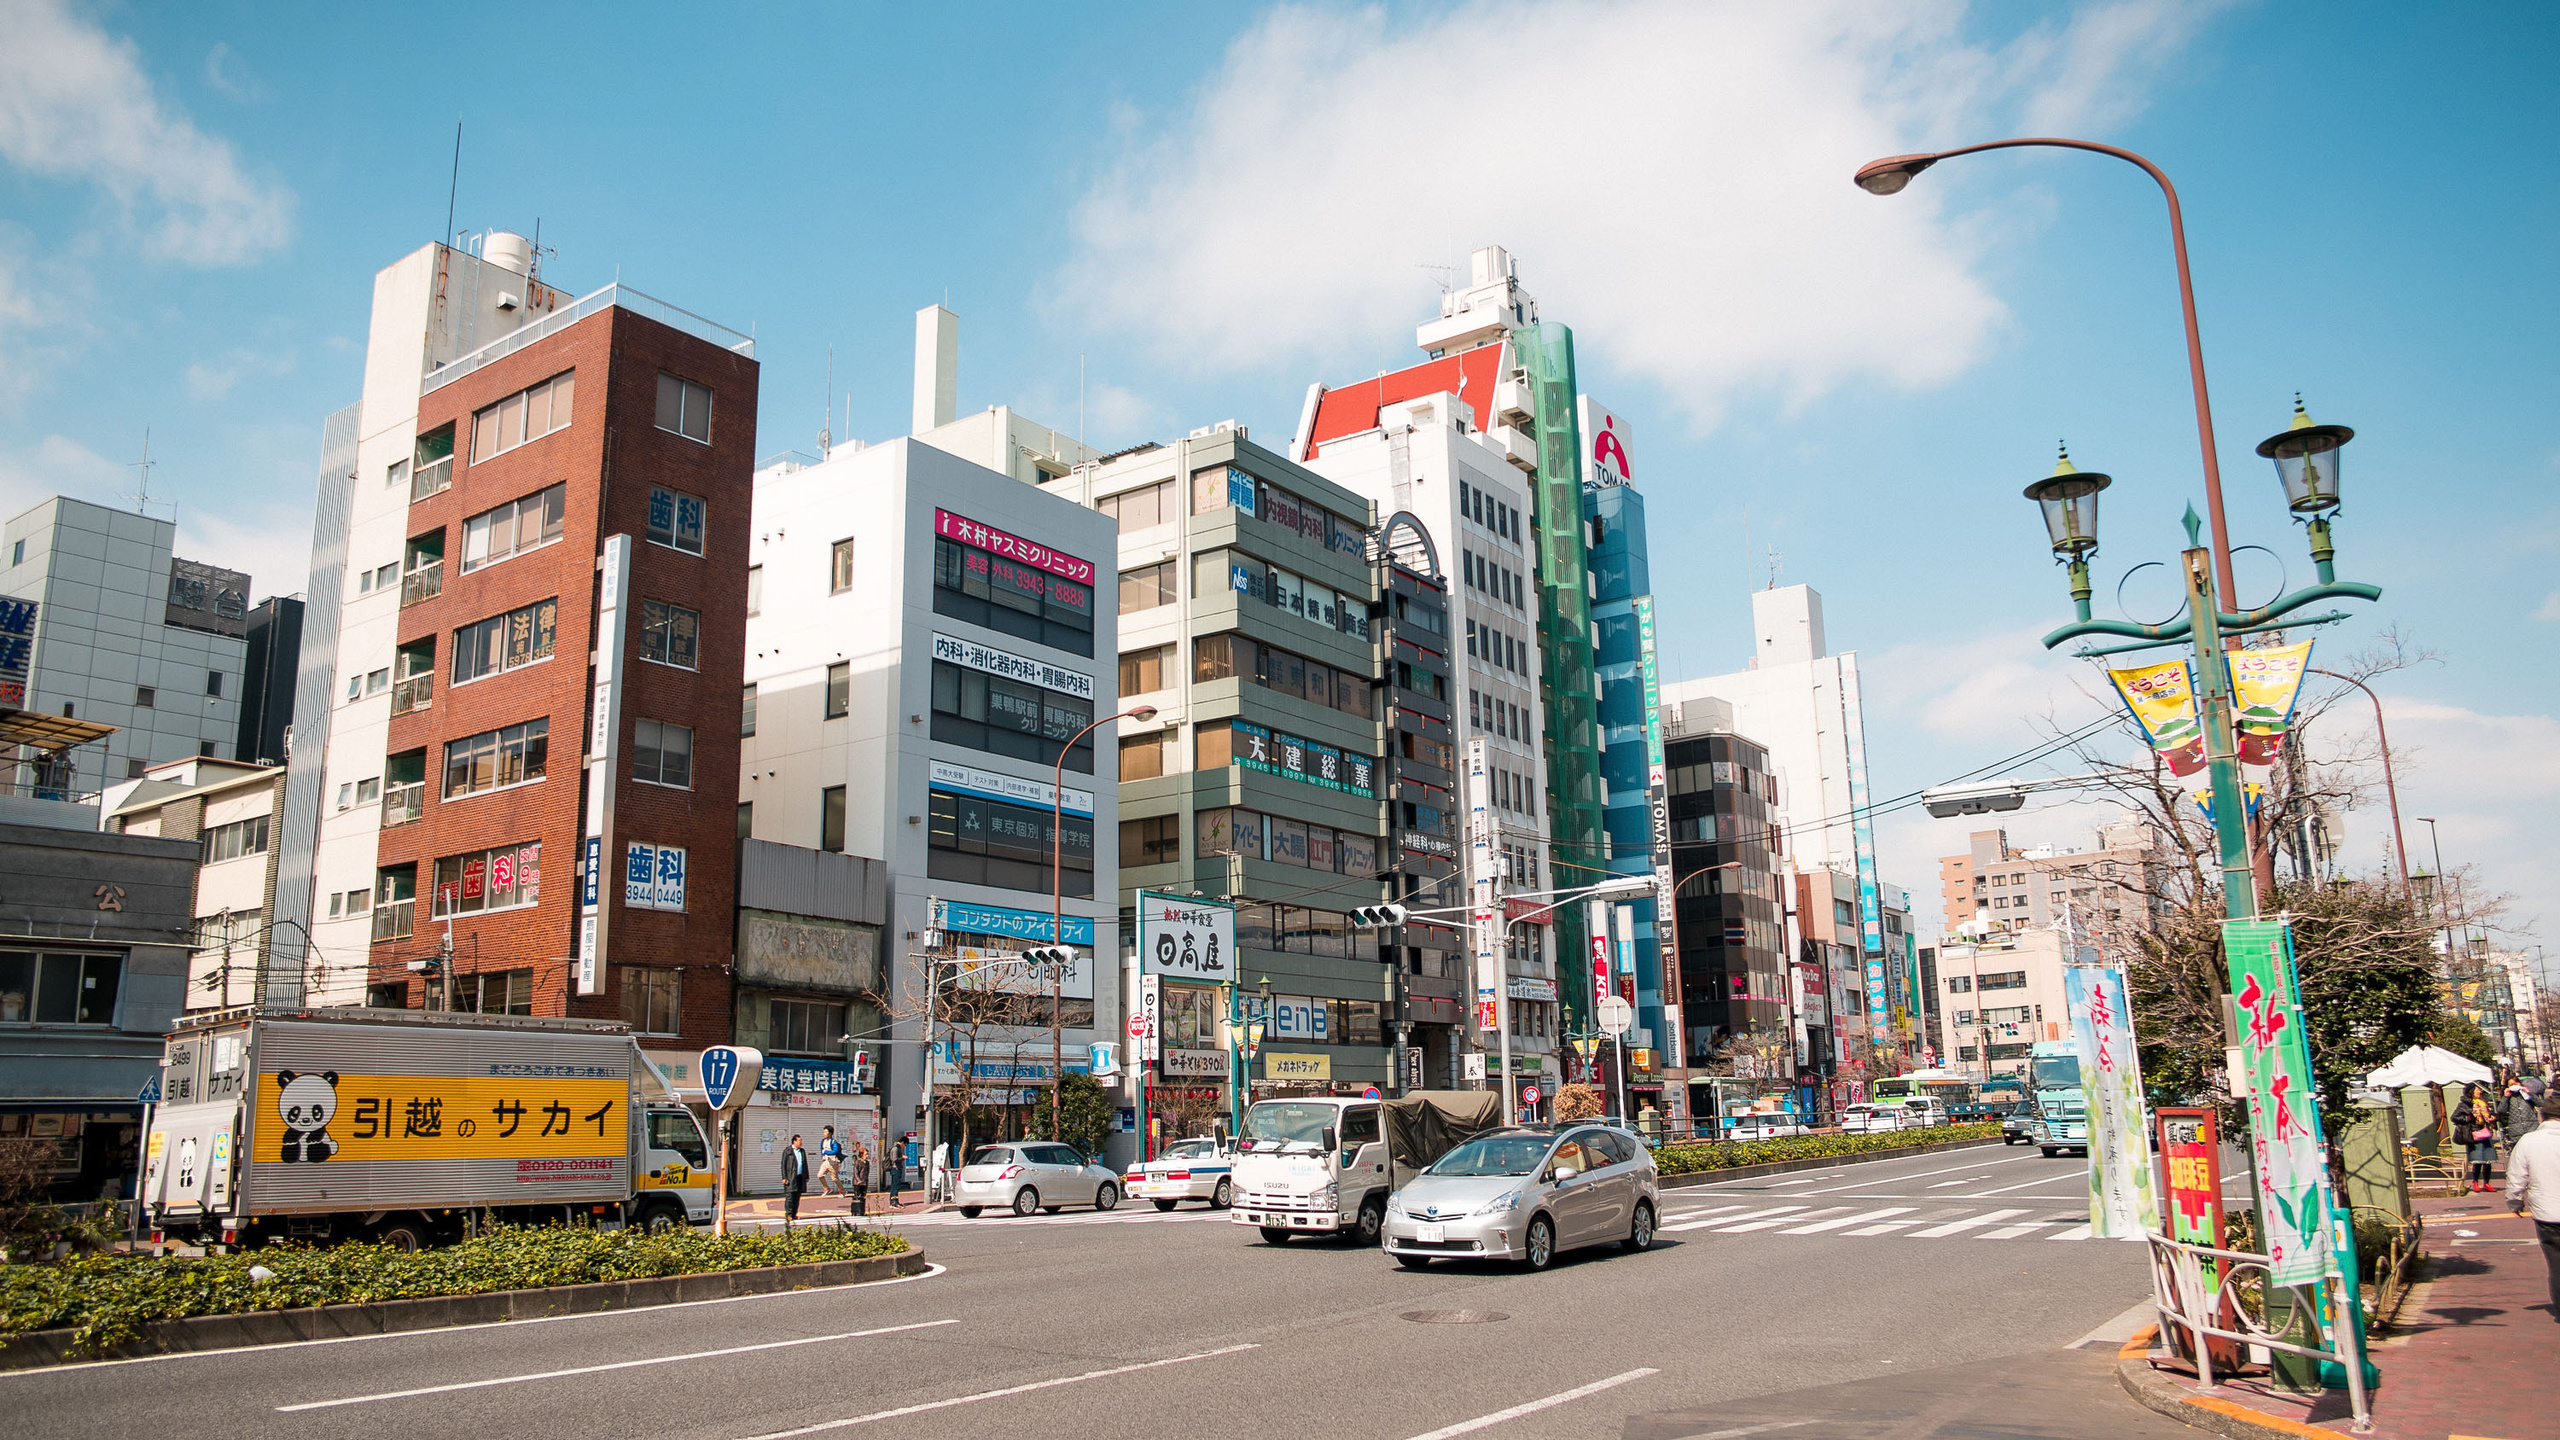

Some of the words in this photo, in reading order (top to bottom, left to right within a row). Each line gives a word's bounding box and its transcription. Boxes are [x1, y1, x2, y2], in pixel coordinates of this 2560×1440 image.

[650, 489, 701, 539] 歯科
[958, 519, 1090, 580] 木村ヤスミクリニック
[513, 604, 557, 642] 法律
[643, 603, 695, 641] 法律
[936, 638, 1091, 697] 内科・消化器内科・胃腸内科
[2235, 656, 2300, 673] ようこそ
[2125, 667, 2183, 695] ようこそ
[991, 692, 1088, 731] 巣鴨駅前胃腸内科
[1020, 716, 1069, 740] クリニック
[1249, 736, 1369, 789] 大建総業
[991, 816, 1091, 849] 東京個別指導学院
[1652, 796, 1668, 855] TOMAS
[627, 845, 684, 888] 歯科
[1274, 831, 1306, 860] 大腸
[1344, 844, 1375, 871] クリニック
[463, 853, 515, 900] 歯科
[95, 884, 125, 913] 公
[626, 883, 653, 902] 3944
[657, 888, 683, 905] 0449
[1156, 930, 1225, 973] 日高屋
[1869, 964, 1887, 1039] カラオケ館
[1278, 1005, 1327, 1033] ena
[1667, 1023, 1678, 1062] SoftBank
[209, 1069, 246, 1095] サカイ
[489, 1064, 616, 1078] まごころこめておつきあい
[710, 1062, 729, 1086] 17
[761, 1066, 863, 1095] 美保堂時計店
[1276, 1060, 1321, 1074] メガネドラッグ
[708, 1087, 728, 1097] ROUTE
[792, 1095, 824, 1106] 閉店セール
[353, 1095, 615, 1141] 引越のサカイ
[532, 1159, 613, 1171] 0120-001141
[667, 1165, 690, 1185] No.1
[1358, 1160, 1375, 1169] USEFUL
[2246, 1066, 2283, 1277] ご予約承り中
[1263, 1181, 1290, 1190] ISUZU
